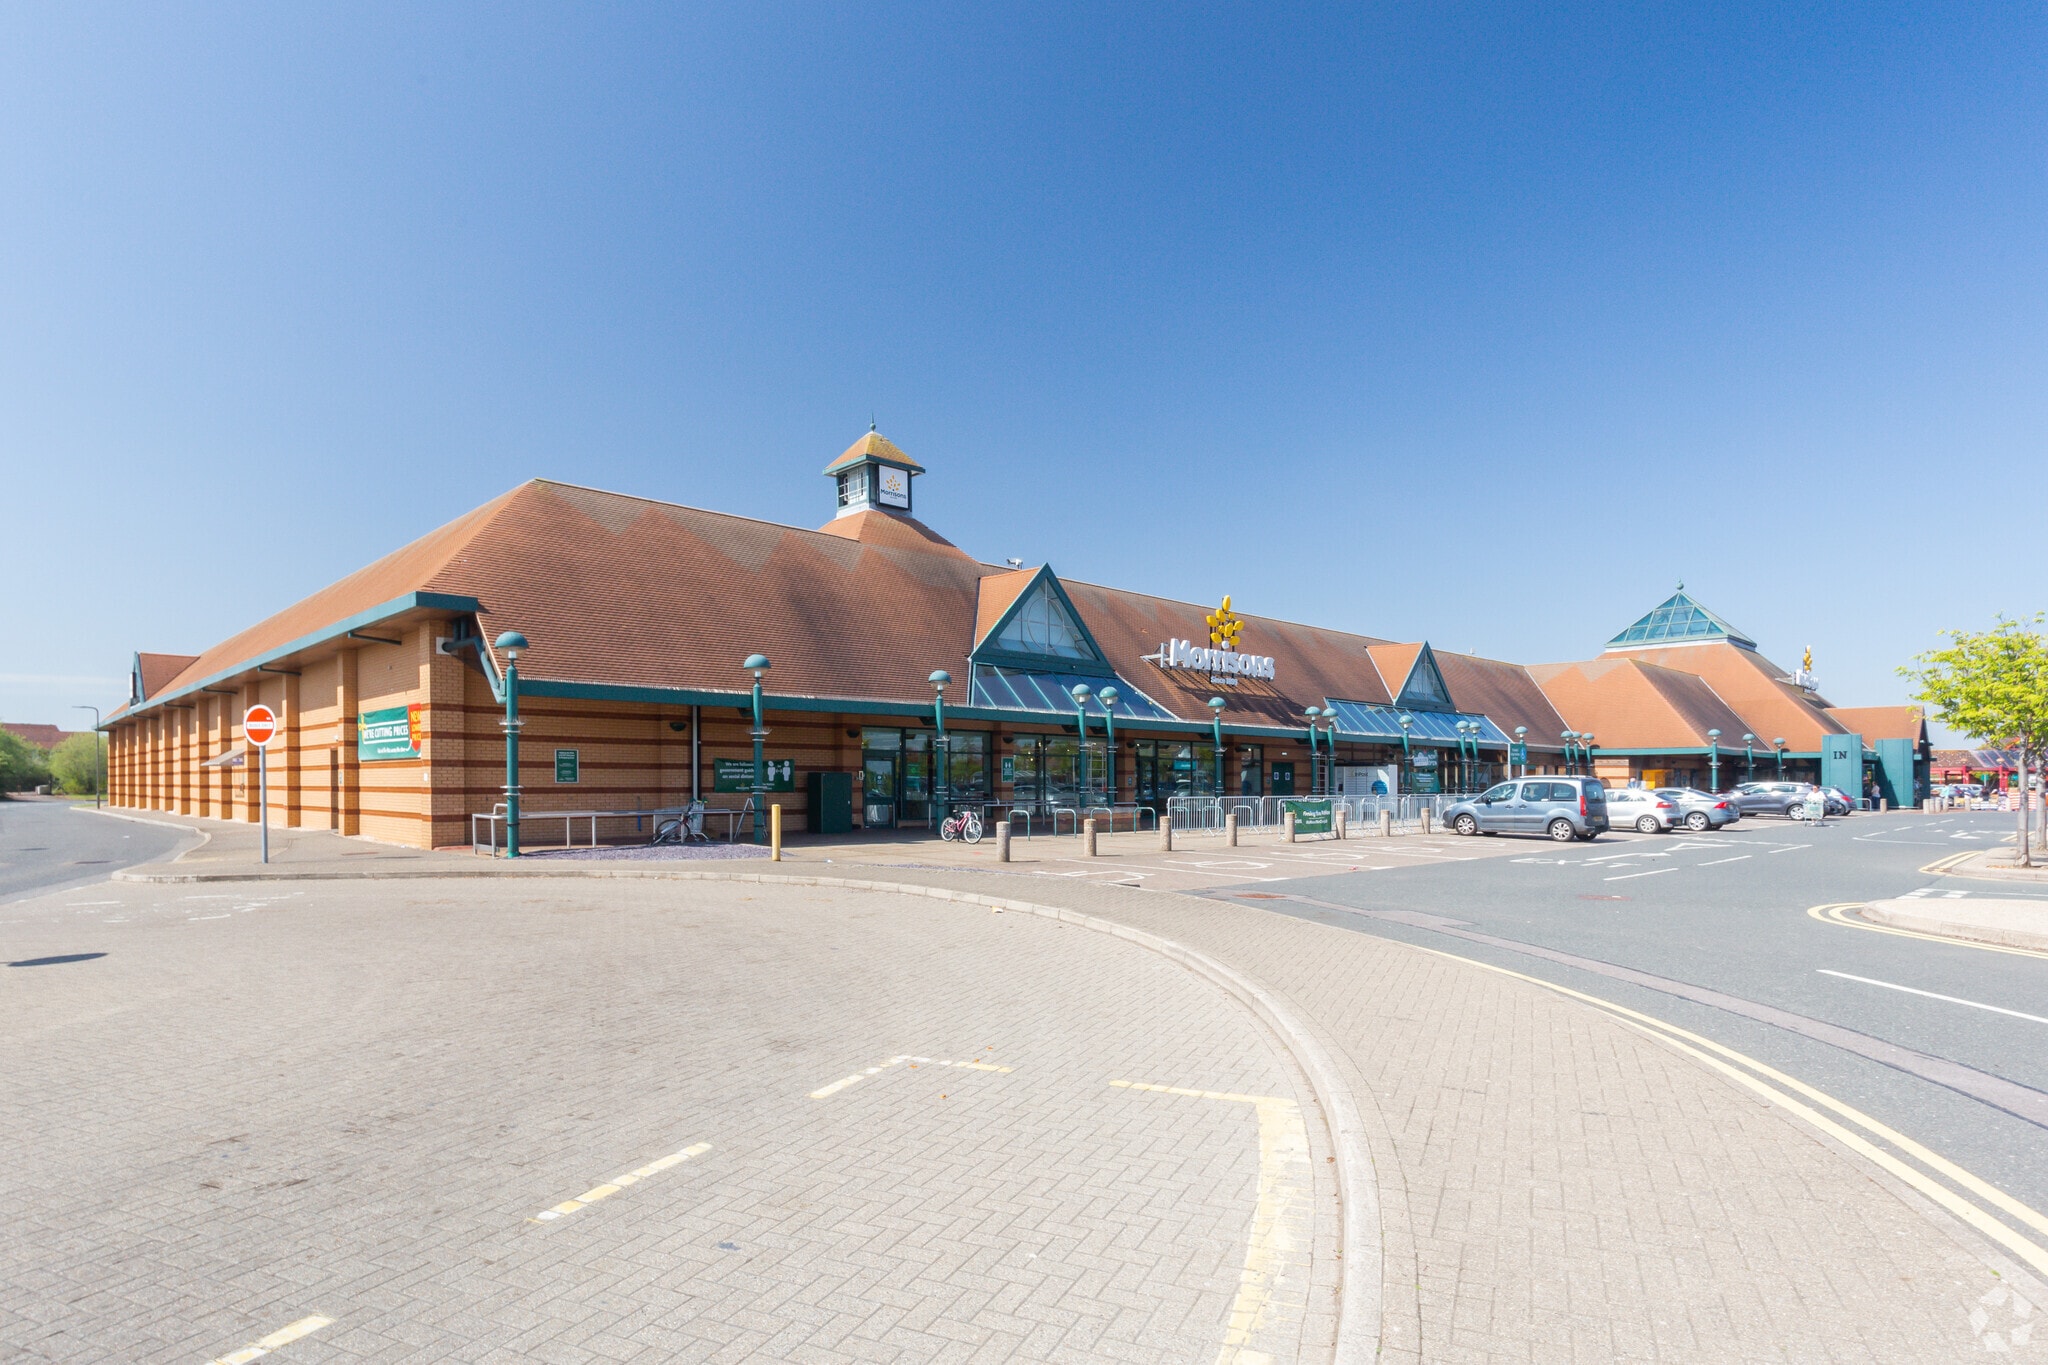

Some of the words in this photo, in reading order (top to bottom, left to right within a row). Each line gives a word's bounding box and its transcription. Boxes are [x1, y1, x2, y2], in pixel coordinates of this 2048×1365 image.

[880, 488, 906, 499] Morrisons
[1169, 638, 1275, 679] Morrisons
[1210, 675, 1225, 685] Since
[410, 710, 420, 722] NEW
[375, 726, 393, 738] CUTTING
[393, 724, 409, 736] PRICES
[1833, 751, 1847, 760] IN
